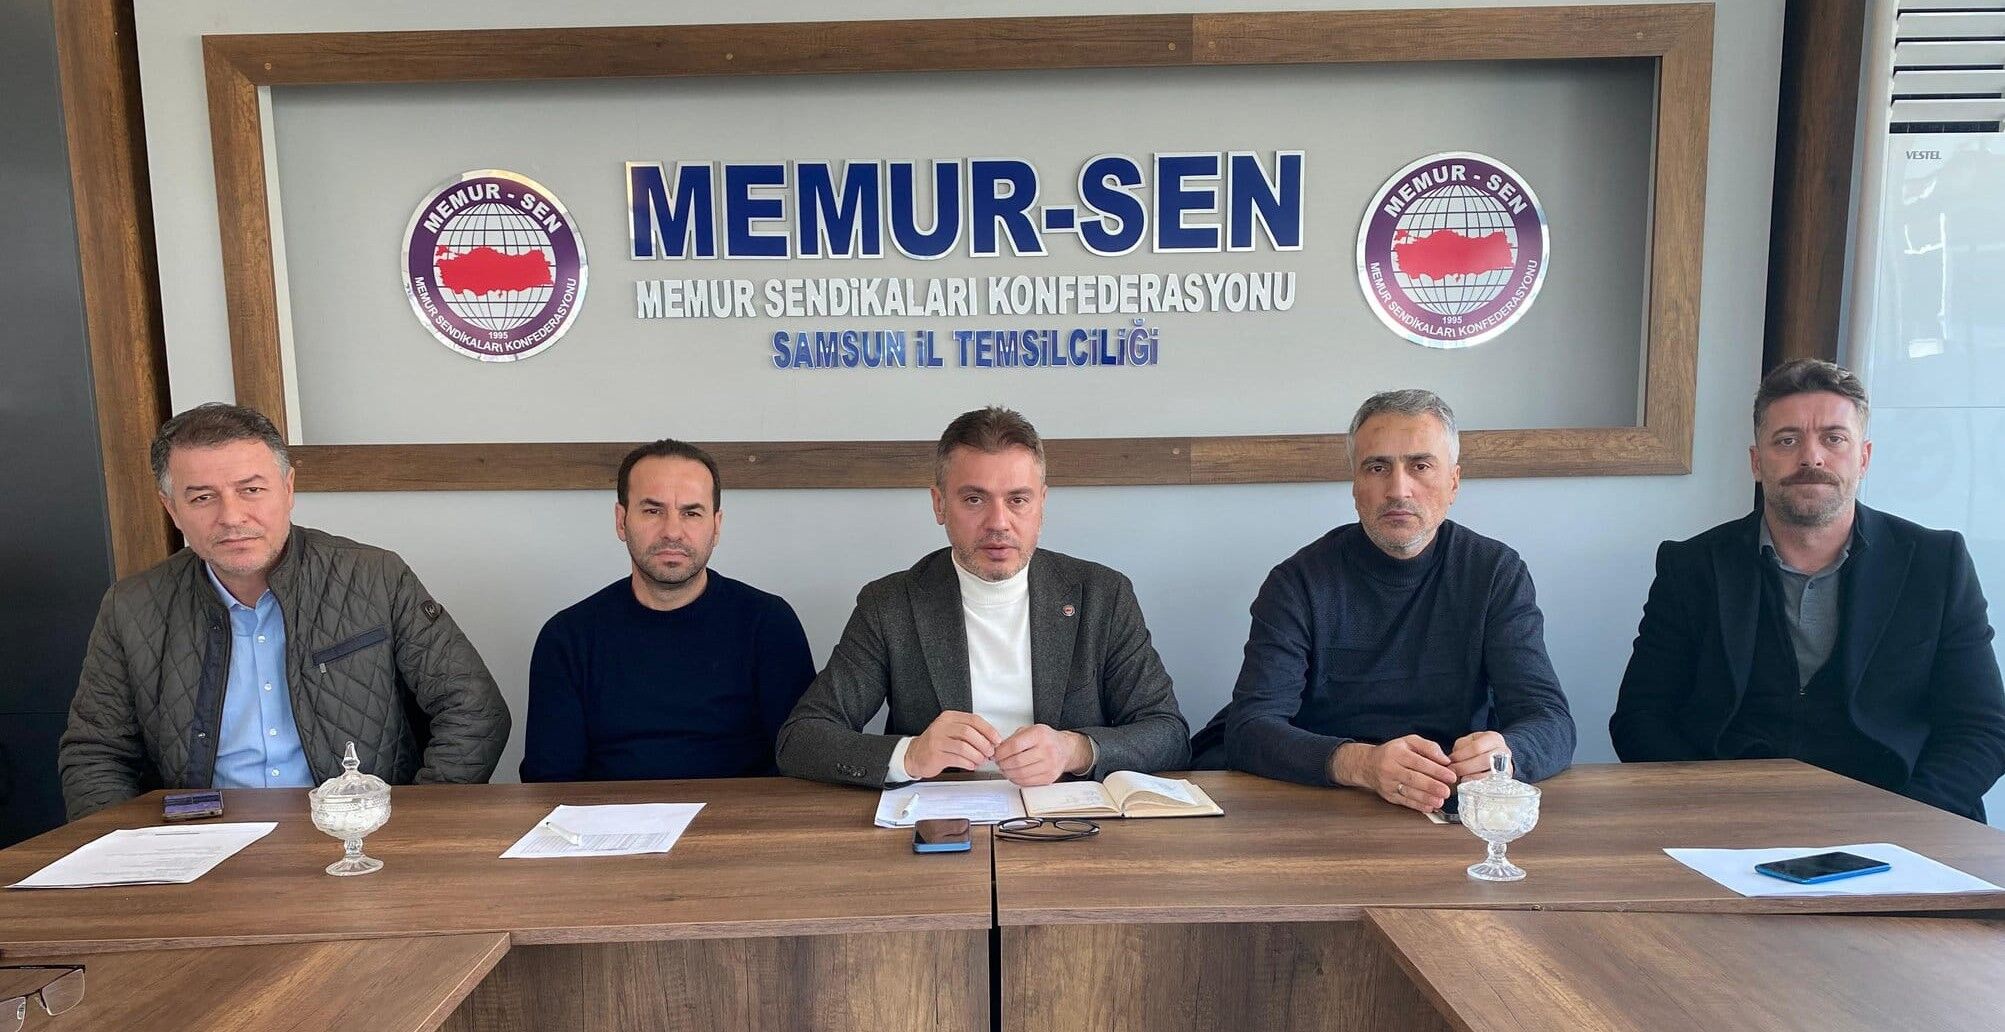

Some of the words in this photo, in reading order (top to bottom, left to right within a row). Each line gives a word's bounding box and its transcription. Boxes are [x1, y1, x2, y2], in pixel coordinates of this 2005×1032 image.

[1905, 150, 1942, 160] VESTEL
[423, 183, 501, 234] MEMUR
[520, 193, 562, 234] SEN
[624, 150, 1305, 260] MEMUR-SEN
[1383, 164, 1466, 218] MEMUR
[1486, 174, 1528, 215] SEN
[414, 276, 437, 317] MEMUR
[505, 278, 577, 352] KONFEDERASYONU
[636, 278, 756, 319] MEMUR
[988, 271, 1296, 316] KONFEDERASYONU
[1370, 261, 1392, 303] MEMUR
[1459, 259, 1538, 337] KONFEDERASYONU
[1442, 315, 1463, 324] 1995
[488, 331, 509, 340] 1995
[772, 329, 906, 370] SAMSUN
